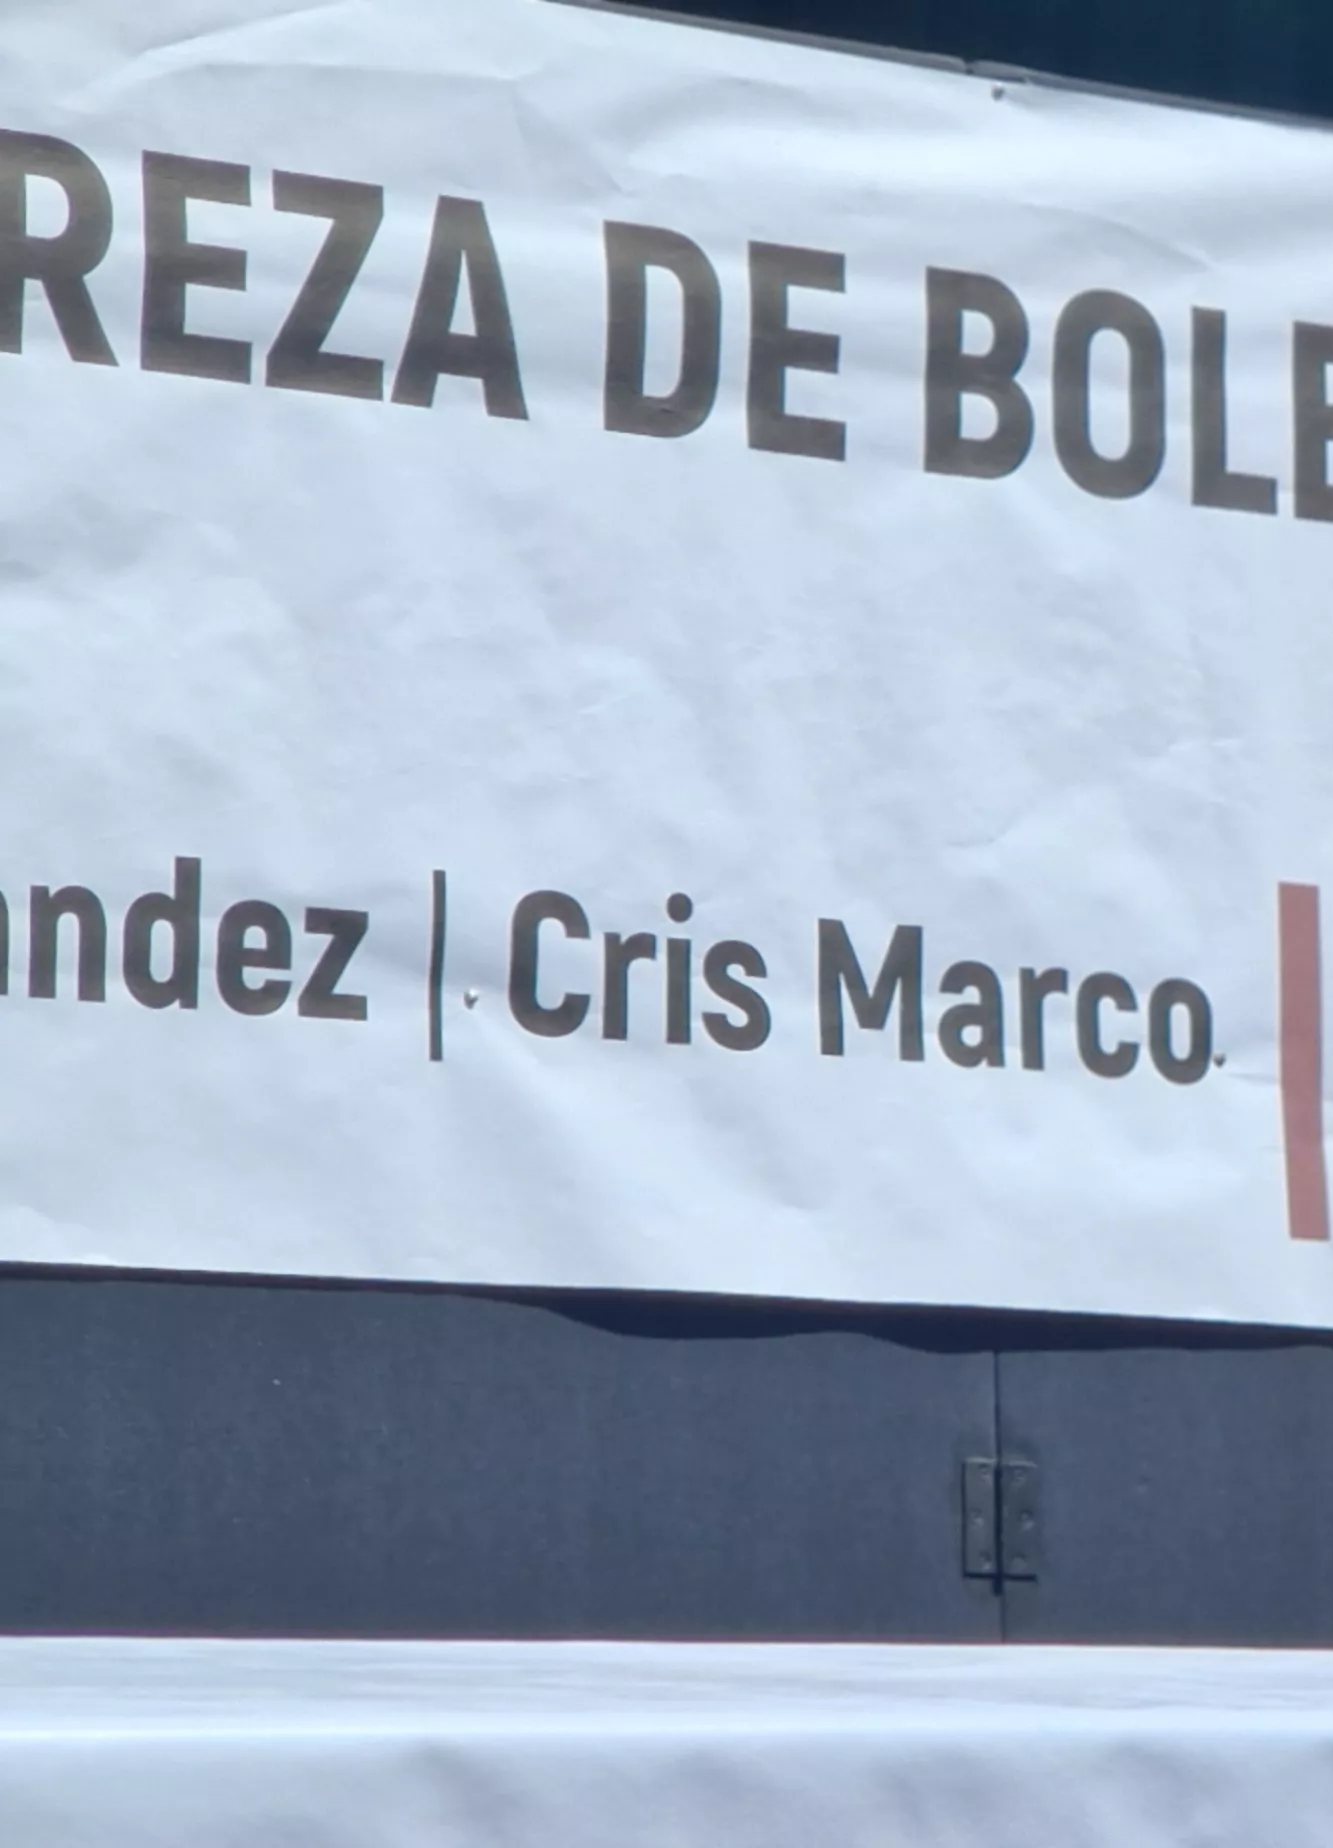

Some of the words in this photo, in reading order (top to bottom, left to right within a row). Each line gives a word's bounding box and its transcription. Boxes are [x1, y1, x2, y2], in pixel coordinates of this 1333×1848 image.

[603, 219, 847, 463] DE
[0, 855, 369, 1021] ndez
[507, 889, 772, 1053] Cris
[816, 916, 1214, 1086] Marco
